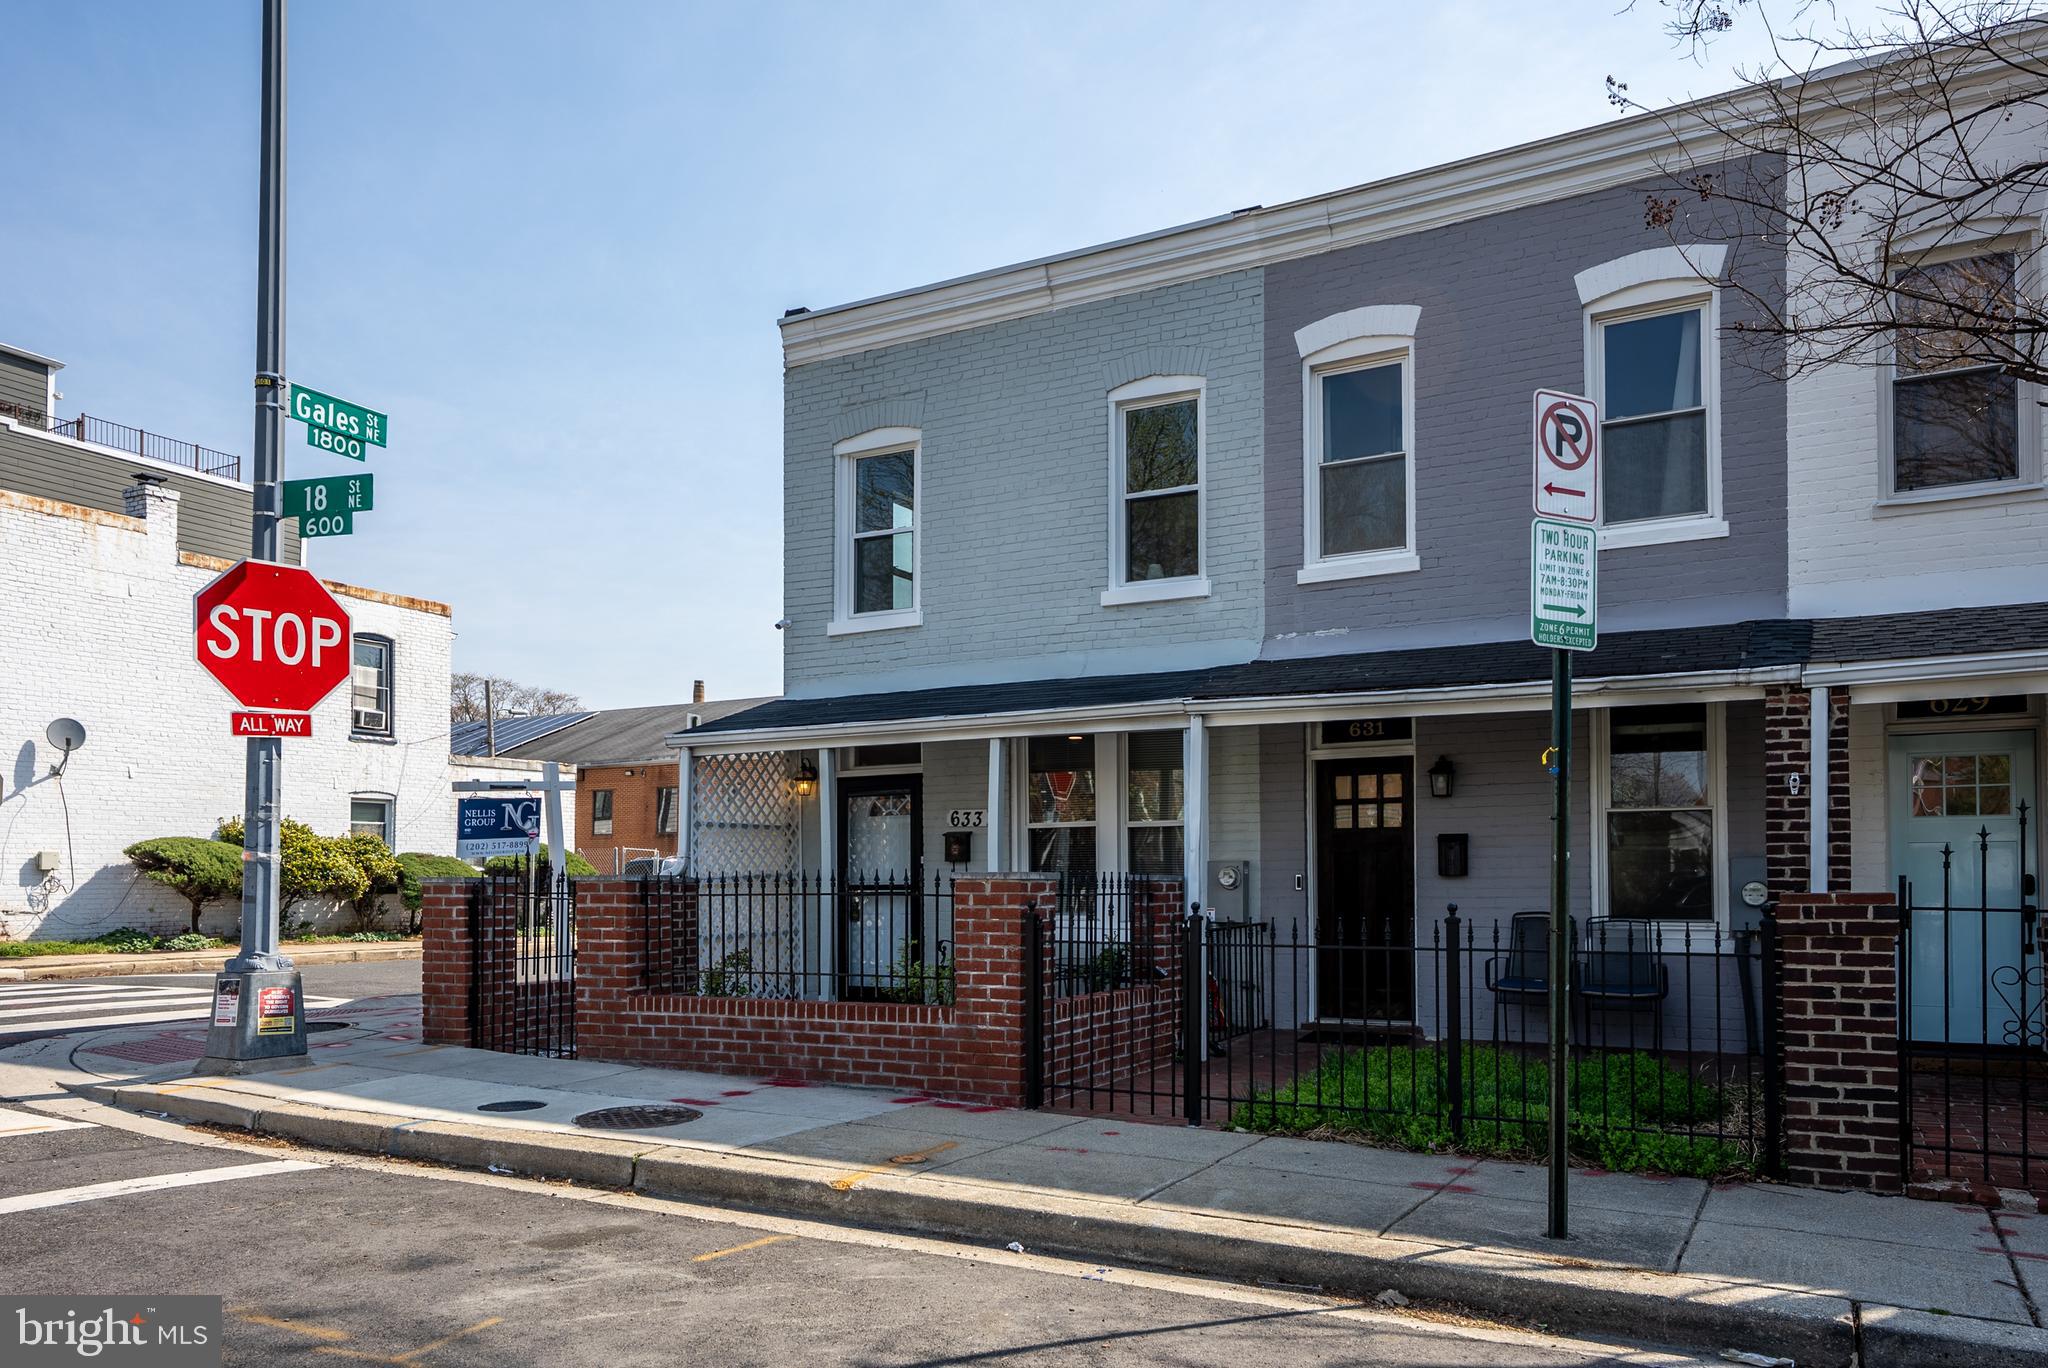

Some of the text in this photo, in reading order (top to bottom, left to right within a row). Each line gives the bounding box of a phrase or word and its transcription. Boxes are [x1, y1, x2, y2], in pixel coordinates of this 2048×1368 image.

[296, 392, 378, 435] Gales St
[313, 428, 360, 457] 1800
[366, 427, 380, 442] NE
[304, 480, 361, 512] 18 St
[348, 494, 362, 508] NE
[306, 515, 344, 535] 600
[1541, 529, 1588, 550] TWO HOUR
[1544, 548, 1584, 565] PARKING
[1539, 562, 1590, 577] LIMIT IN ZONE 6
[1540, 573, 1588, 589] 7AM-8:30PM
[1540, 587, 1588, 600] MONDAY-FRIDAY
[207, 604, 342, 667] STOP
[1540, 622, 1590, 637] ZONE 6 PERMIT
[240, 717, 304, 733] ALL WAY
[1350, 721, 1384, 737] 631
[464, 809, 496, 818] NELLIS
[950, 810, 983, 827] 633
[464, 818, 496, 827] GROUP
[466, 841, 529, 851] (202) 517-8899
